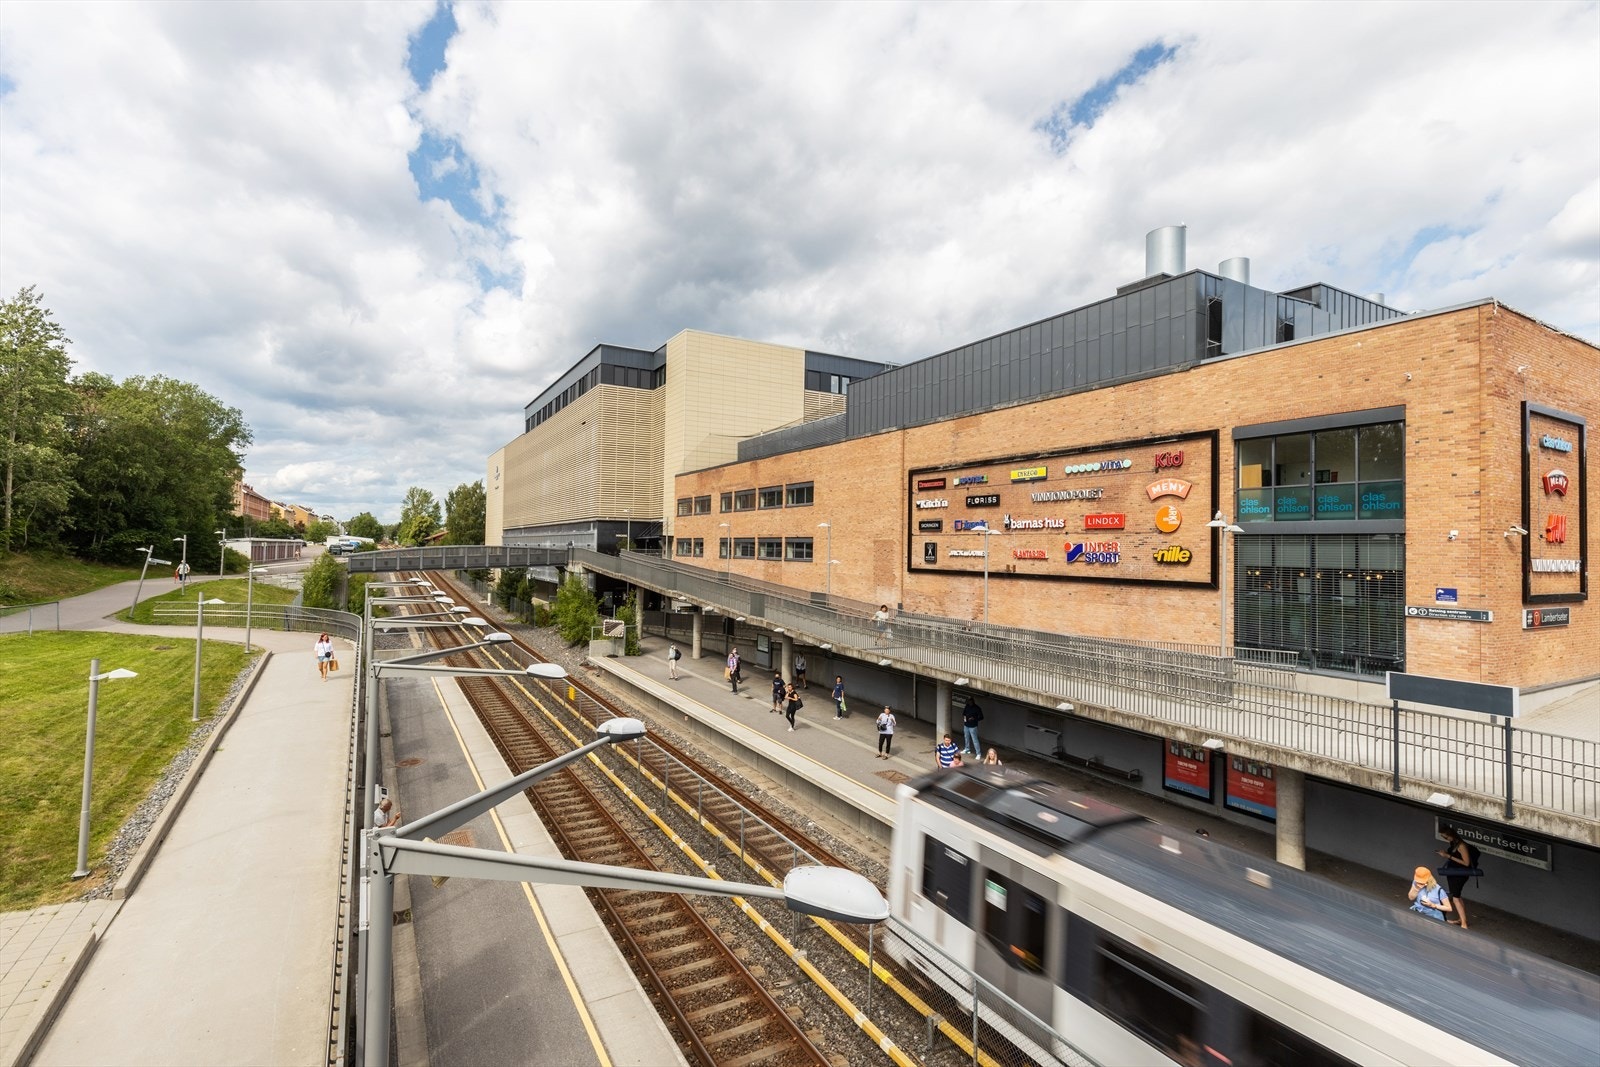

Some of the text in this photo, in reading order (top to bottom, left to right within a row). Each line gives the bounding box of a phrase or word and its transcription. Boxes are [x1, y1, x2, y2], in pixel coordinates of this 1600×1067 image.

[1155, 450, 1184, 468] Kid
[1101, 459, 1123, 470] VITA
[1550, 476, 1567, 488] MENY
[1151, 481, 1187, 494] MENY
[967, 496, 997, 505] FLORISS
[1031, 489, 1104, 502] VINMONOPOLET
[1277, 496, 1297, 505] clas
[1317, 494, 1340, 503] clas
[1362, 492, 1386, 502] clas
[1240, 498, 1259, 506] clas
[1317, 502, 1353, 511] ohlson
[1362, 501, 1400, 510] ohlson
[1240, 505, 1270, 514] ohlson
[1277, 504, 1309, 513] ohlson
[1011, 517, 1065, 529] barnas hus
[1087, 516, 1120, 525] LINDEX
[1085, 541, 1120, 553] INTER
[1085, 553, 1120, 563] SPORT
[1157, 546, 1191, 562] nille
[1450, 824, 1537, 854] ambertseter
